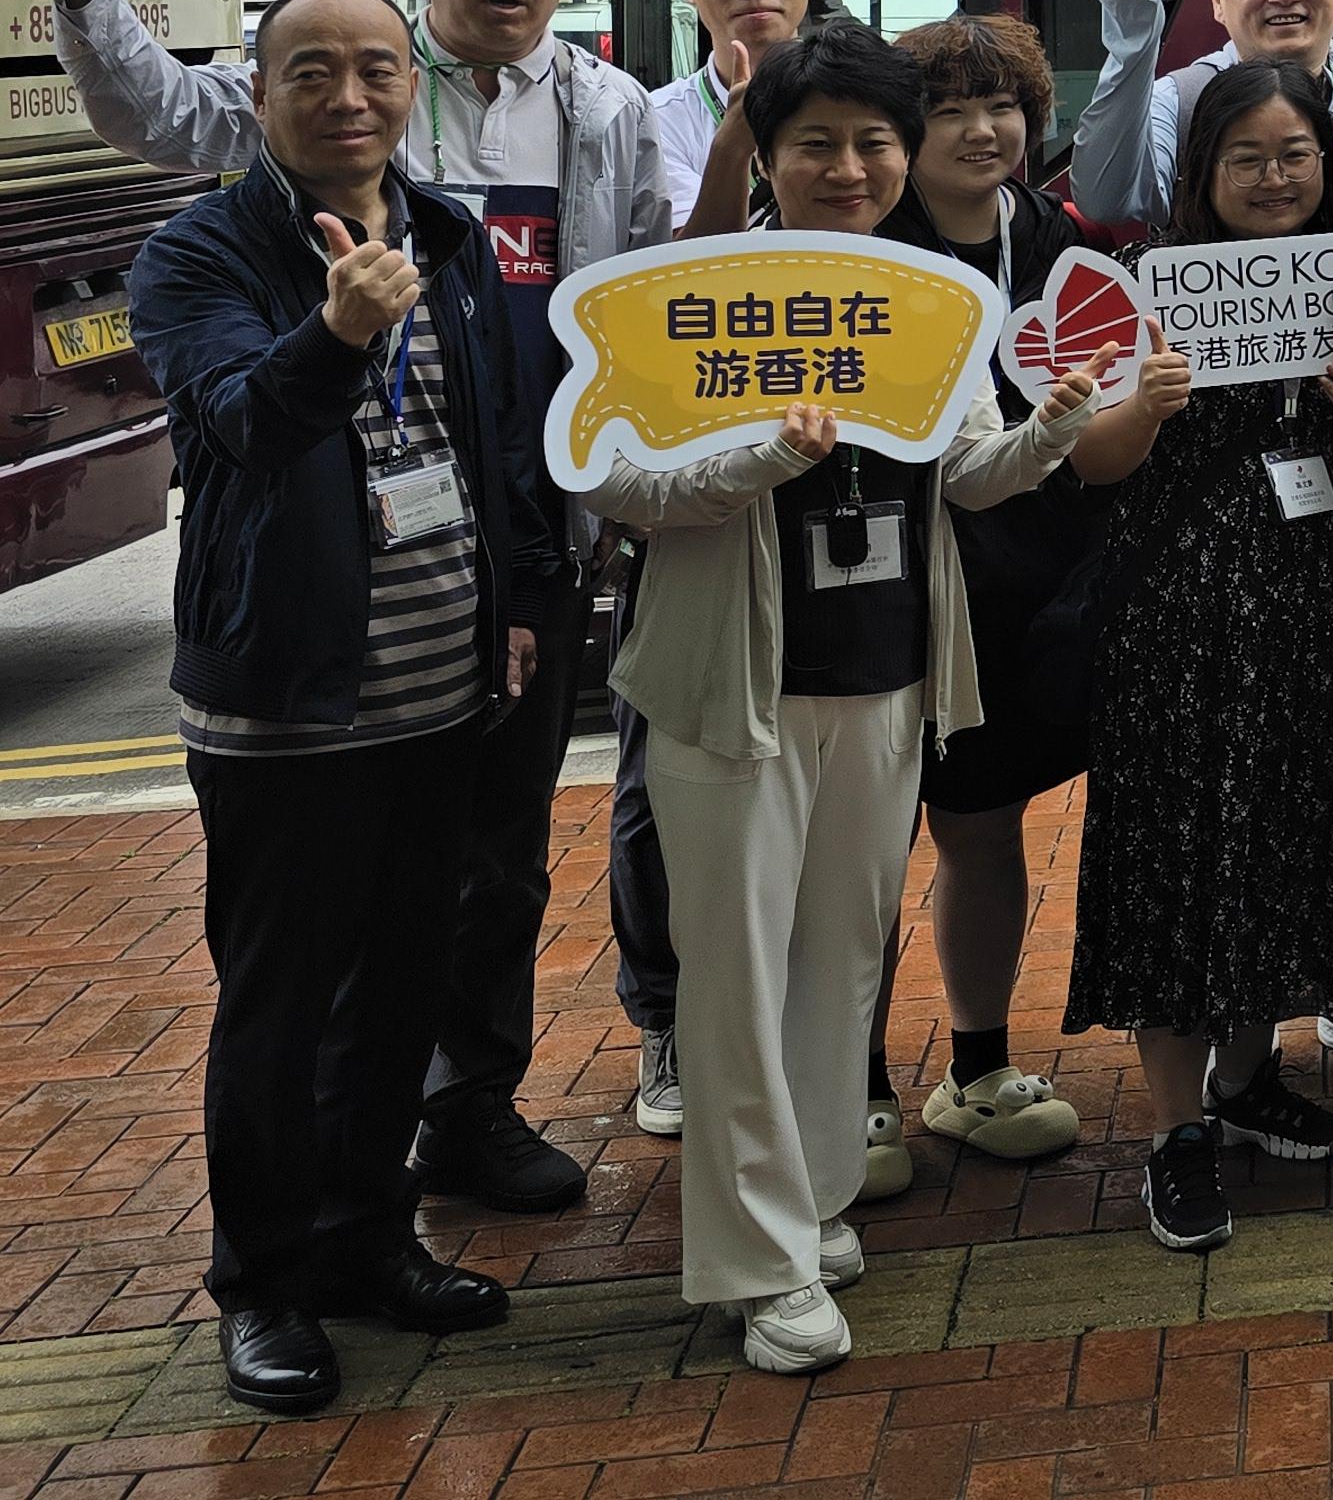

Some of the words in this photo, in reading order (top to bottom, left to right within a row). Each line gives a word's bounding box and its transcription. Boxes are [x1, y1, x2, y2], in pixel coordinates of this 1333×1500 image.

[29, 5, 54, 43] 85
[132, 3, 170, 38] 995
[10, 85, 85, 120] BIGBUS
[513, 261, 555, 275] RAC
[1152, 254, 1281, 298] HONG
[667, 290, 892, 340] 自由自在
[1155, 294, 1297, 332] TOURISM
[695, 345, 866, 398] 游香港
